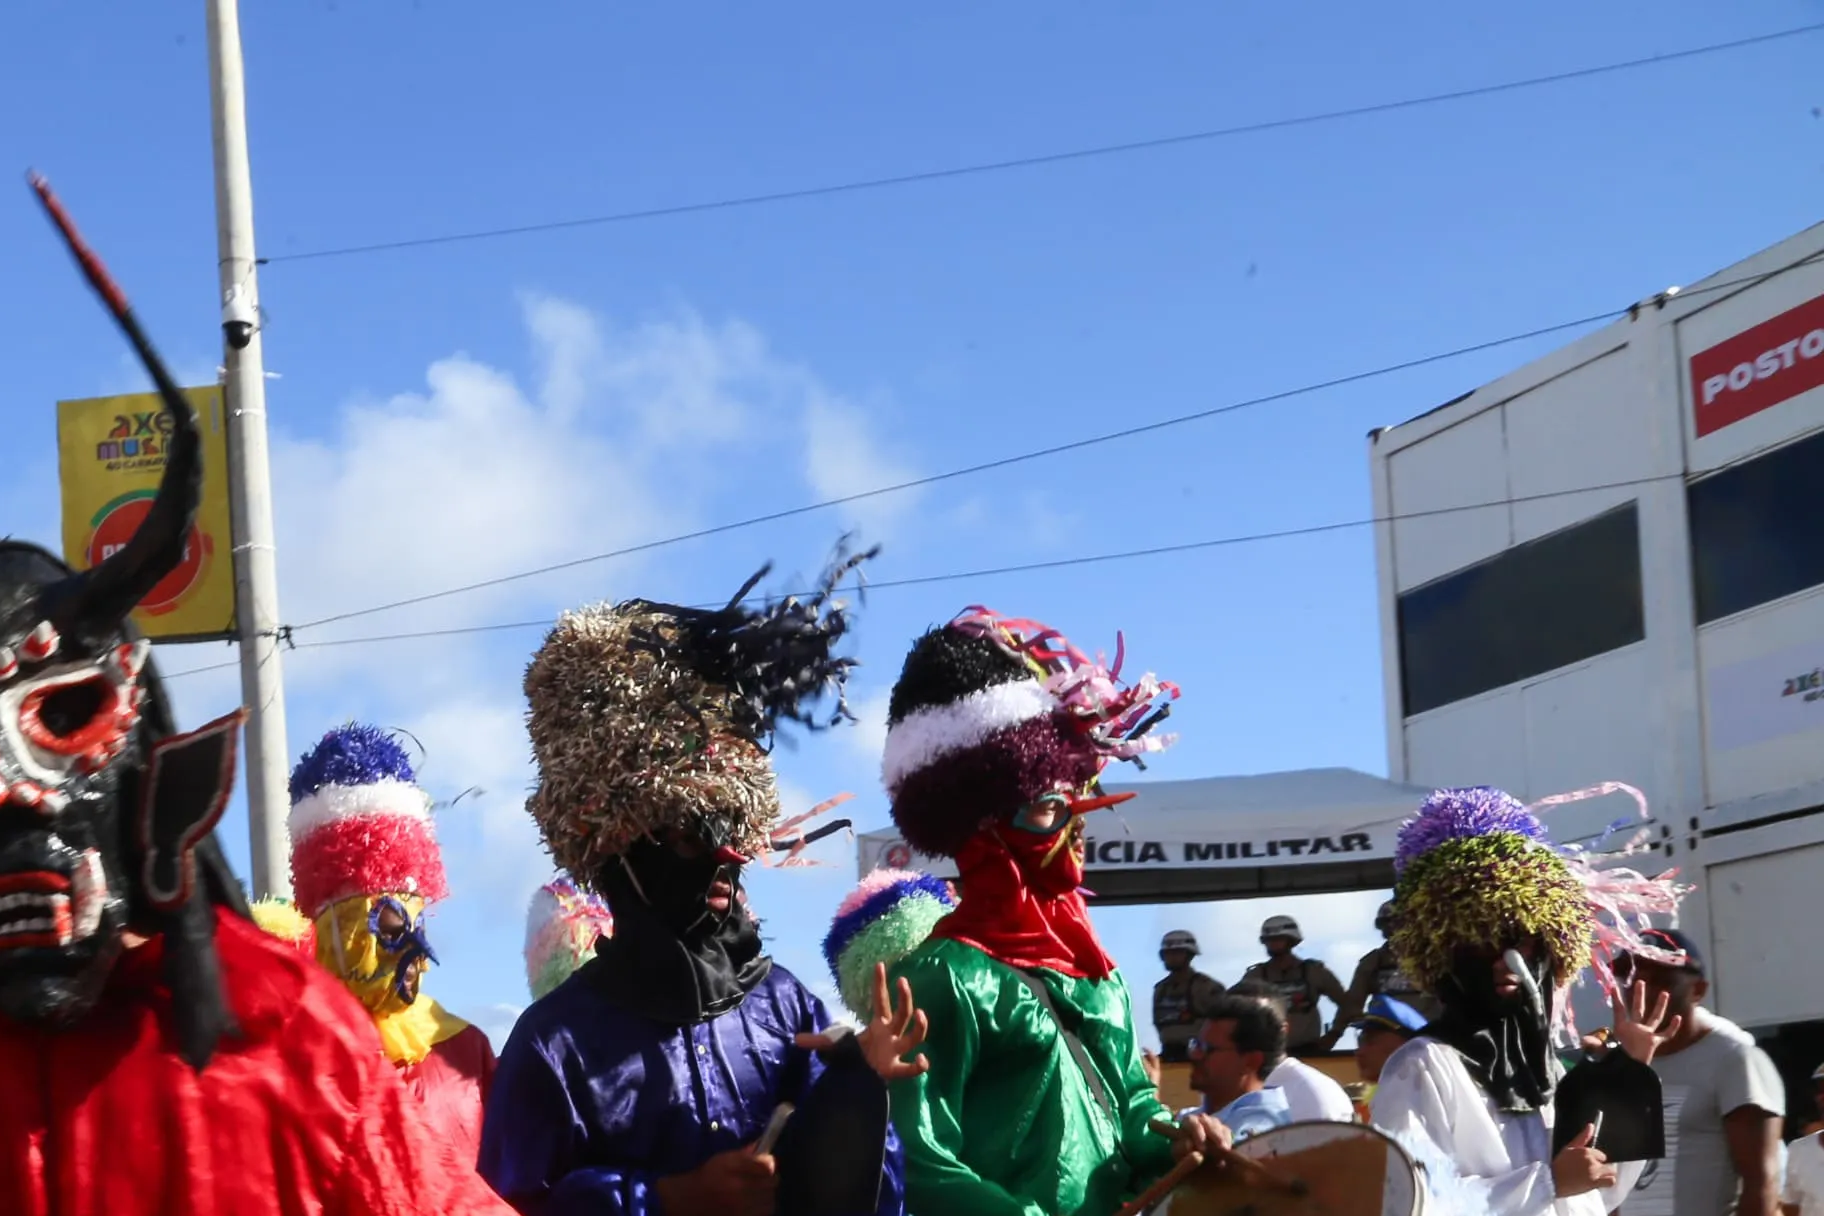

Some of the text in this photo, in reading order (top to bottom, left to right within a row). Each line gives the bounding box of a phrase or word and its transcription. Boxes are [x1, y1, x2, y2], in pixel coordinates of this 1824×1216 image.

[1702, 328, 1824, 406] POSTO
[96, 436, 169, 461] musi
[1085, 832, 1374, 863] ÍCIA MILITAR
